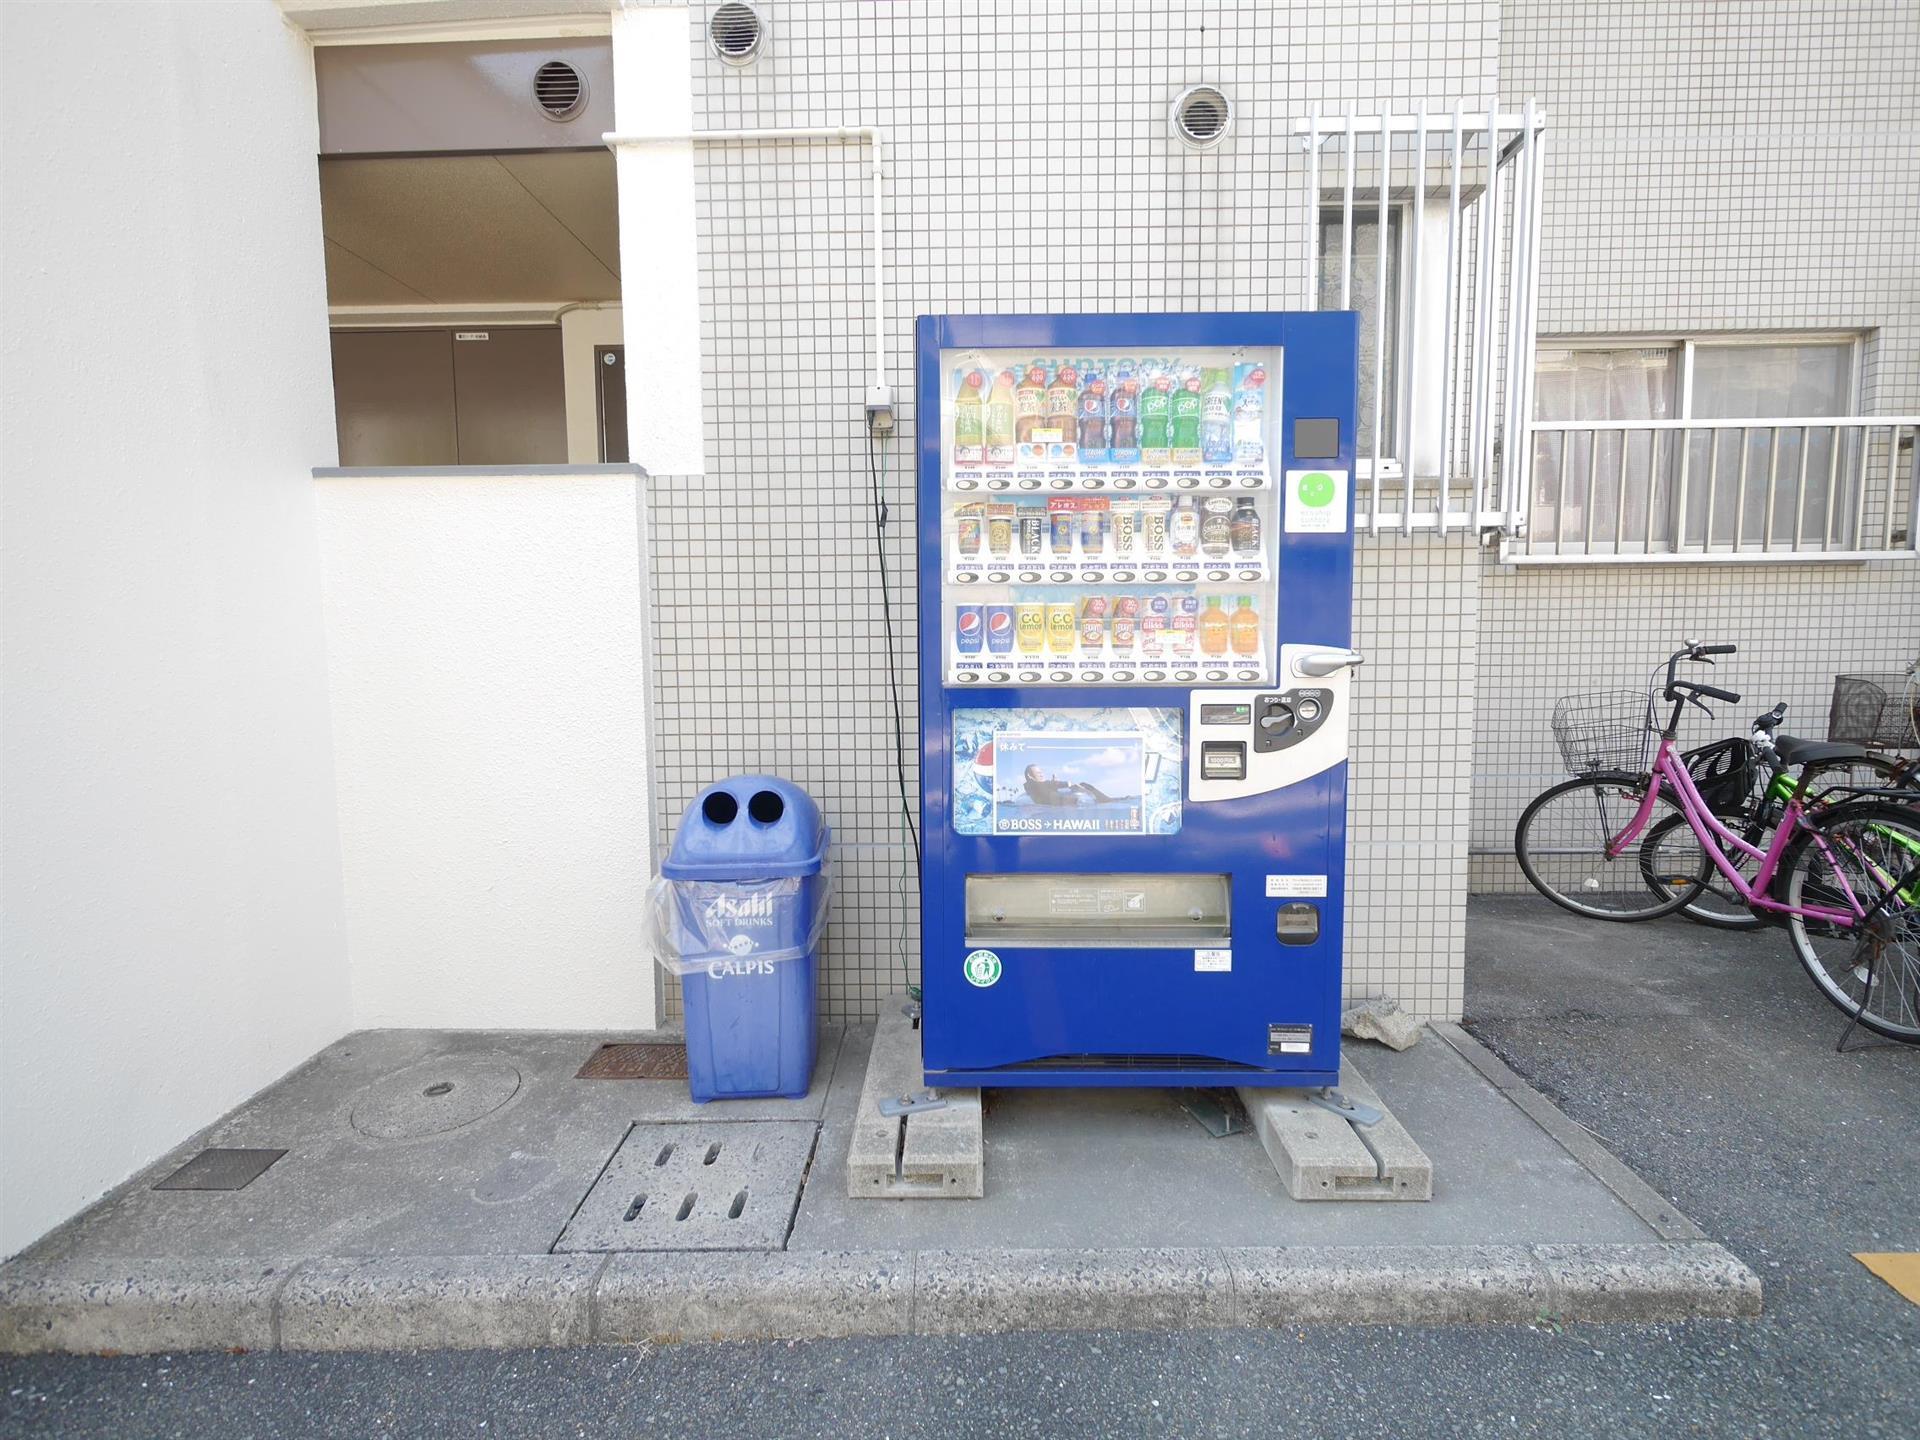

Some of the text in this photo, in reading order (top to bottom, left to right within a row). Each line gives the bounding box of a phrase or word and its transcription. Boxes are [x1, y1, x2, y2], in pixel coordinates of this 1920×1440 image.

[1031, 519, 1040, 554] BLACK
[1123, 516, 1132, 550] BOSS
[1154, 516, 1163, 550] BOSS
[1011, 819, 1100, 830] BOSS HAWAII
[706, 892, 774, 918] Asahi
[706, 917, 773, 928] SOFT DRINKS
[707, 959, 775, 979] CALPIS
